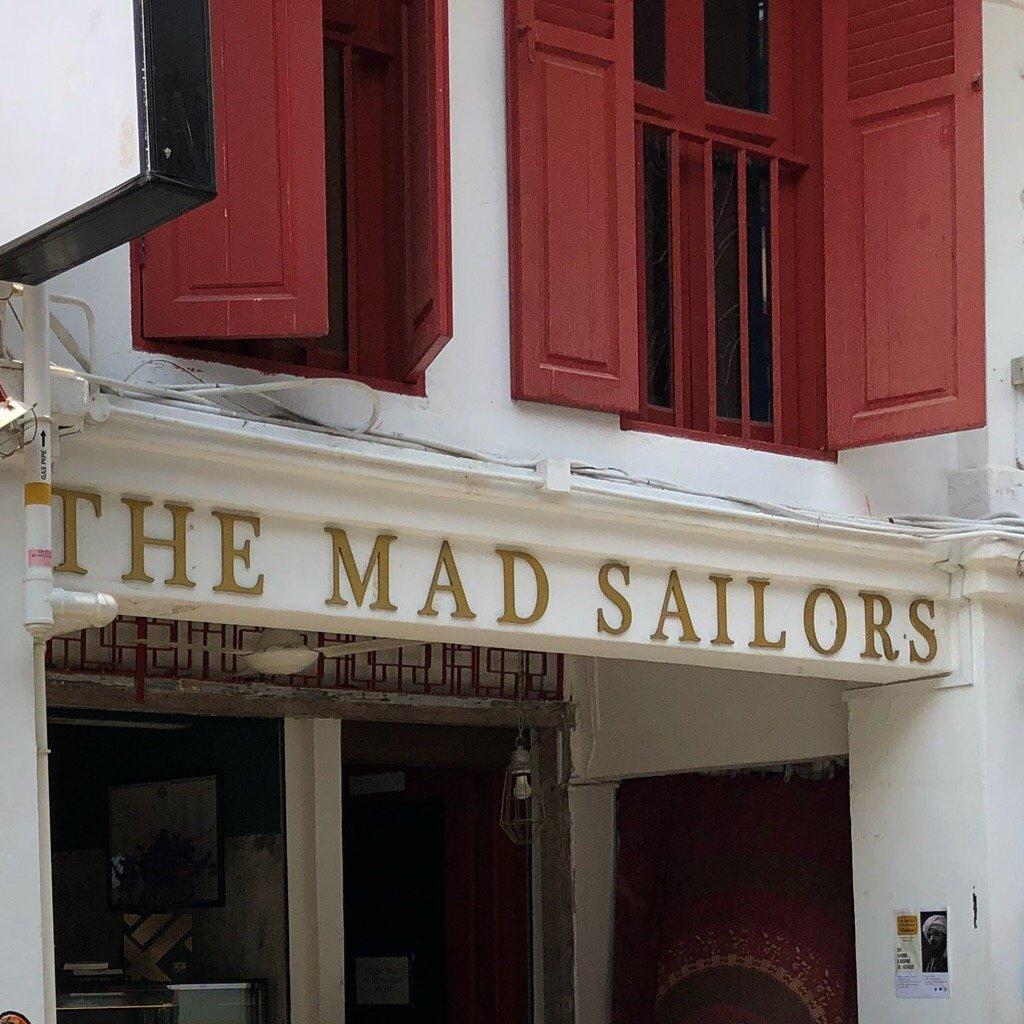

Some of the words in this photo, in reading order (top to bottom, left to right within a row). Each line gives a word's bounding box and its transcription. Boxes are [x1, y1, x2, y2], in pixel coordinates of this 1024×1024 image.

[52, 487, 264, 595] THE
[324, 527, 550, 625] MAD
[597, 562, 938, 663] SAILORS
